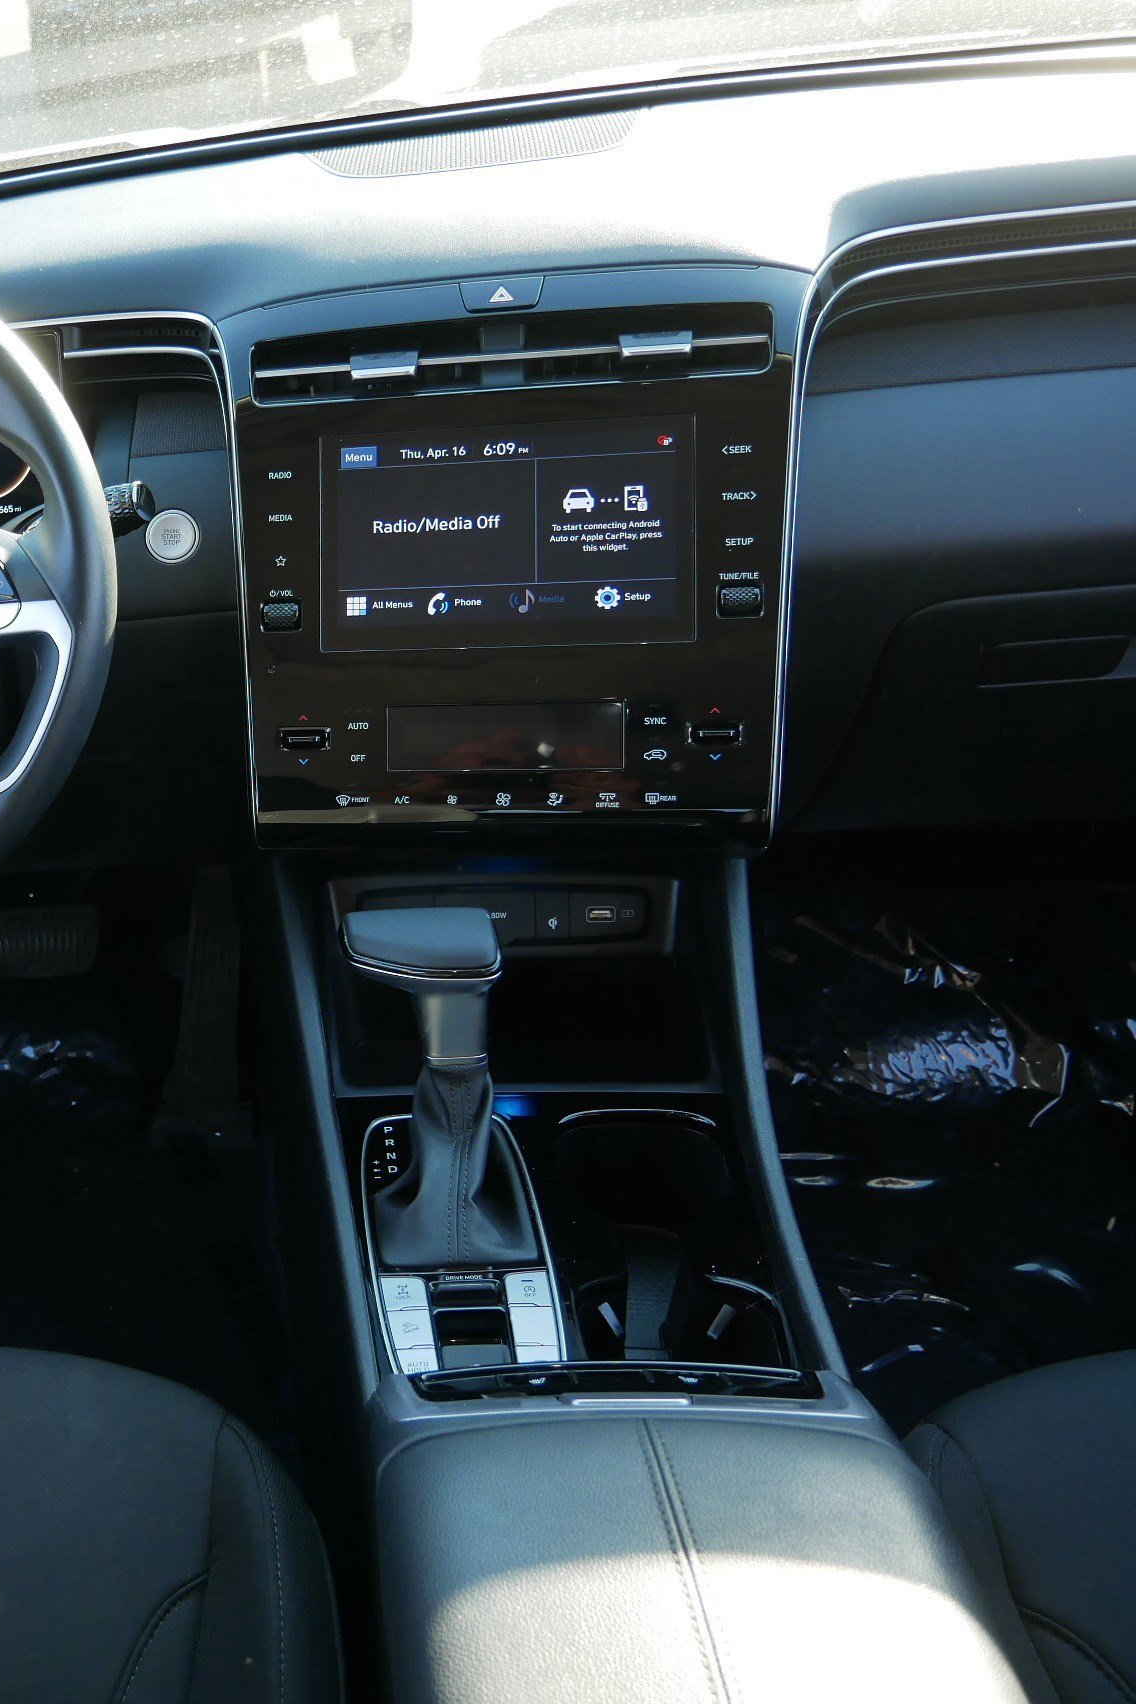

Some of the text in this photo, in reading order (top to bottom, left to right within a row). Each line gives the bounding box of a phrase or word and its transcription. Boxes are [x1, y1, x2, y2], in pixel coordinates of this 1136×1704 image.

[400, 446, 466, 460] Thu, Apr. 16
[483, 442, 516, 456] 6:09
[345, 453, 373, 463] Menu
[268, 471, 292, 480] RADIO
[268, 514, 293, 522] MEDIA
[372, 515, 501, 534] Radio/Media Off
[552, 519, 660, 532] To start connecting Android
[549, 534, 569, 543] Auto
[580, 533, 604, 542] Apple
[639, 531, 662, 540] press
[725, 537, 754, 547] SETUP
[582, 542, 629, 553] this widget.
[719, 571, 759, 581] TUNE/FILE
[624, 592, 651, 602] Setup
[372, 600, 413, 609] All Menus
[454, 598, 482, 607] Phone
[644, 716, 667, 726] SYNC
[347, 722, 369, 731] AUTO
[350, 754, 366, 763] OFF
[394, 796, 410, 805] A/C
[595, 801, 620, 809] DIFFUSE
[383, 1126, 393, 1134] P
[384, 1138, 395, 1147] R
[386, 1152, 397, 1160] N
[387, 1165, 398, 1174] D
